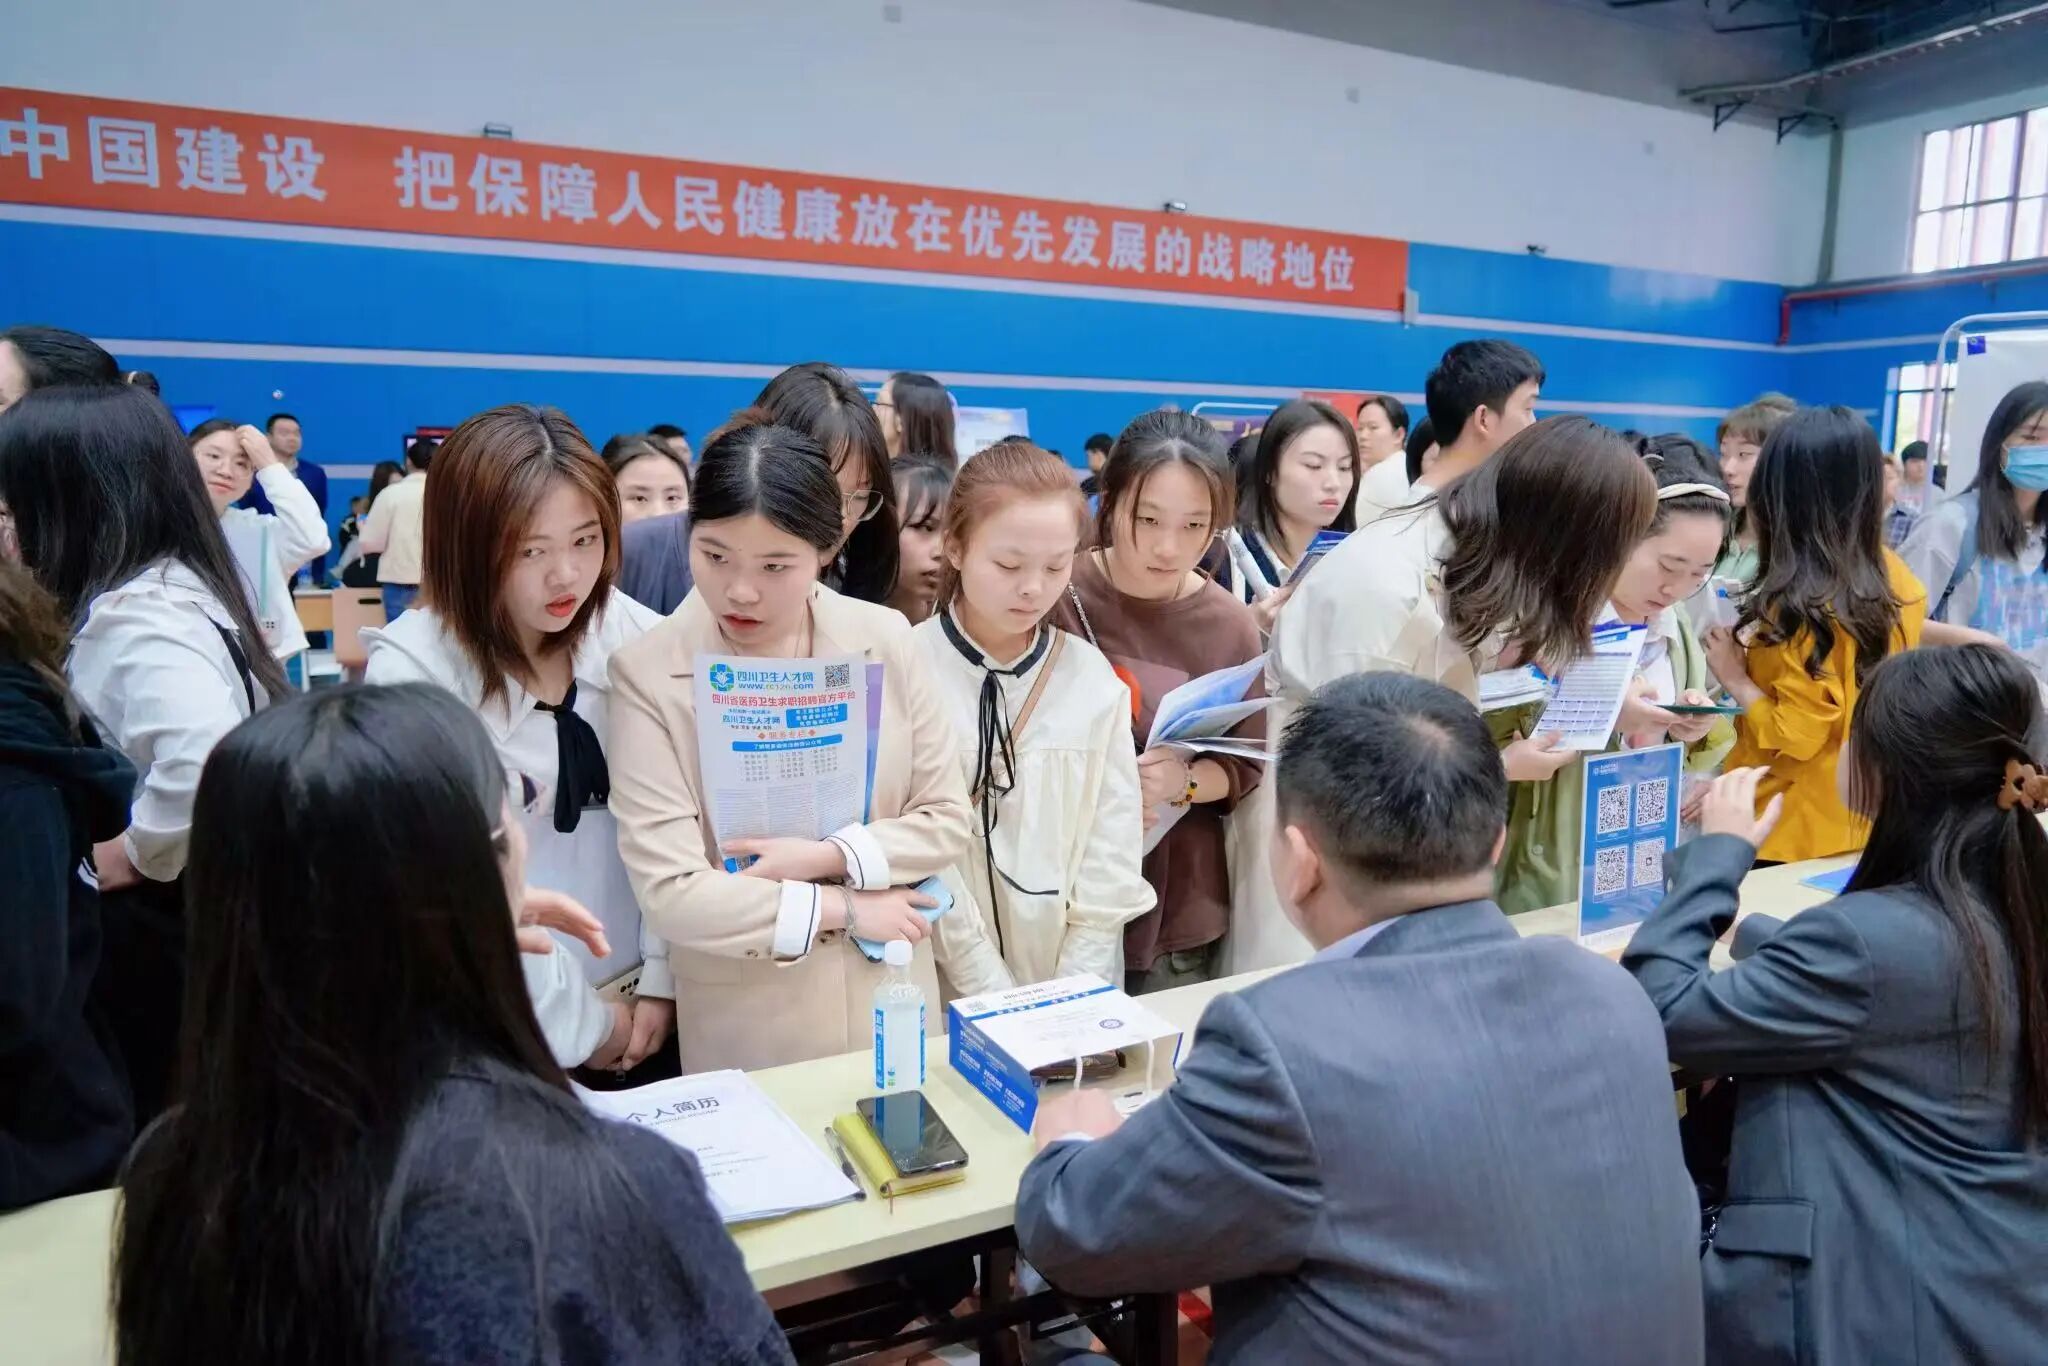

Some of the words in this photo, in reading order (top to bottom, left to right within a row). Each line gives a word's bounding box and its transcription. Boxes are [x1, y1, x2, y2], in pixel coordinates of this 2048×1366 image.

[0, 107, 327, 202] 中国建设
[394, 145, 1356, 292] 把保障人民健康放在优先发展的战略地位
[737, 671, 814, 683] 四川卫生人才网
[712, 690, 856, 707] 四川省医药卫生求职招聘官方平台
[722, 714, 781, 725] 四川卫生人才网
[626, 1096, 720, 1124] 个人简历
